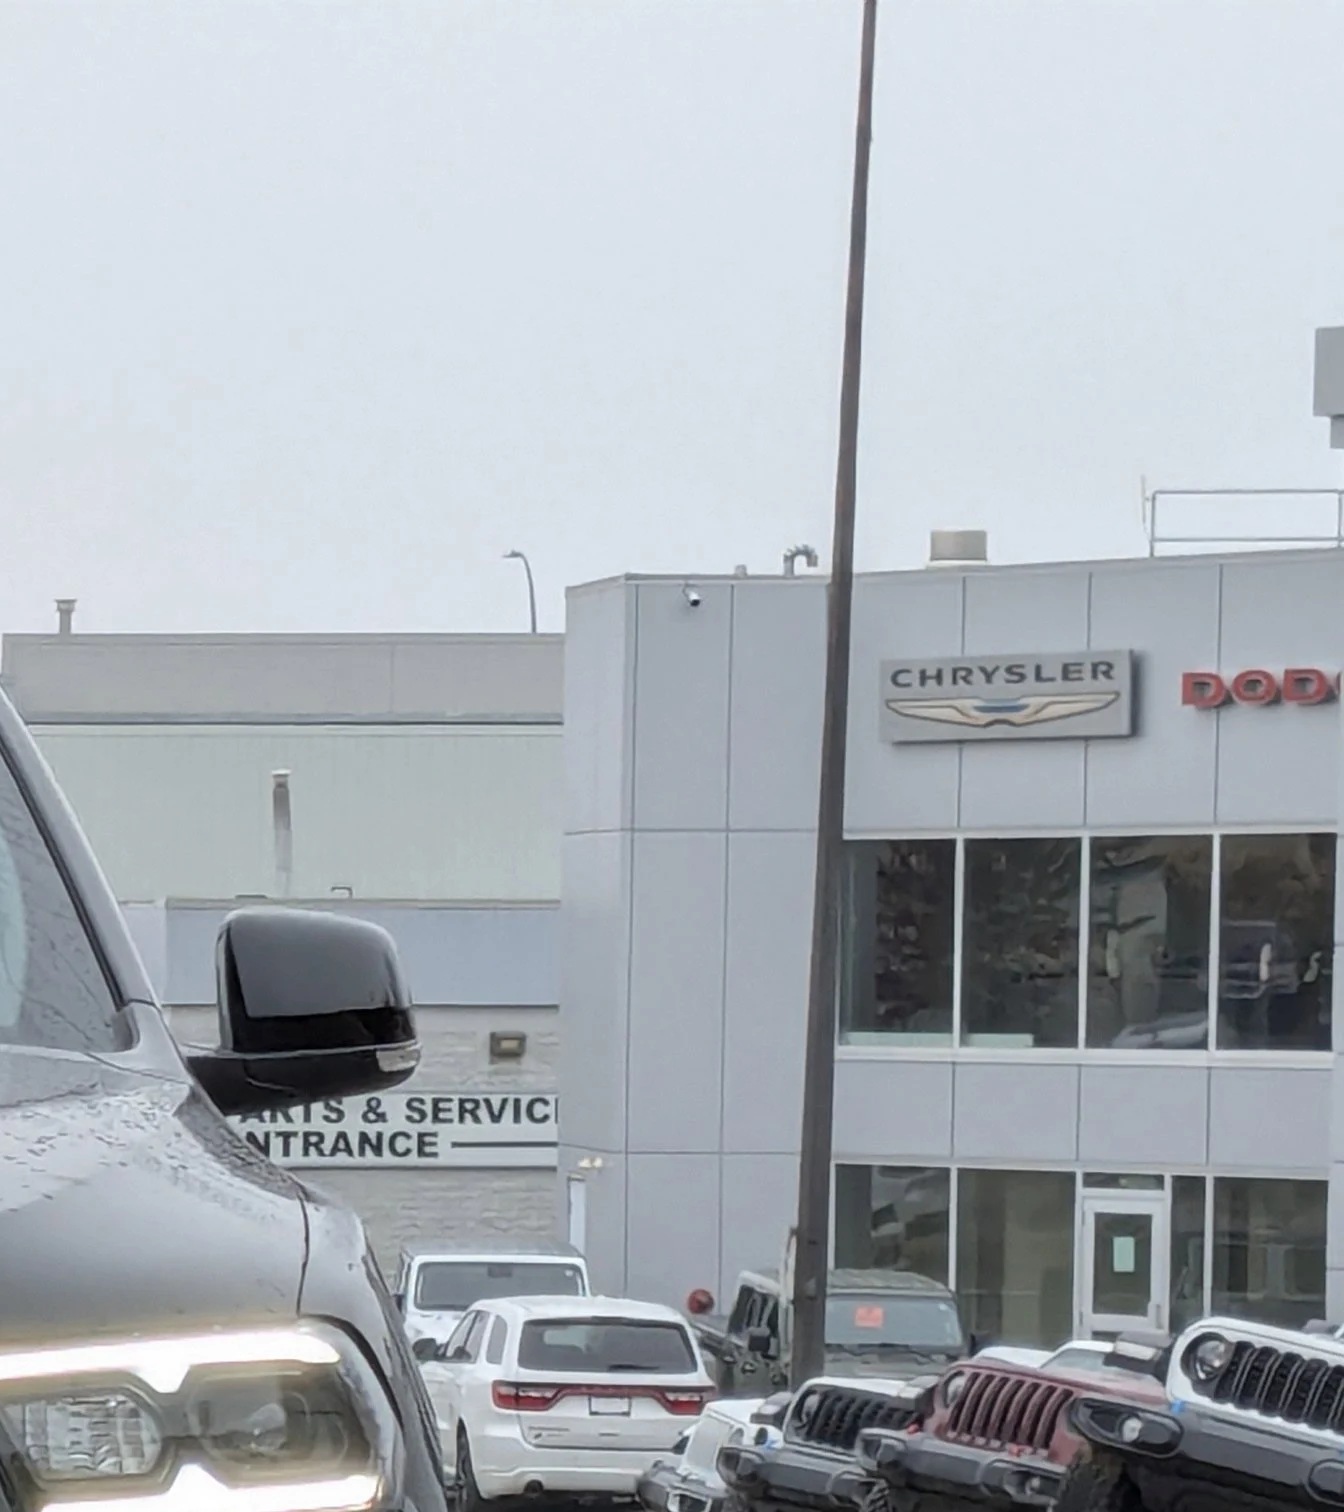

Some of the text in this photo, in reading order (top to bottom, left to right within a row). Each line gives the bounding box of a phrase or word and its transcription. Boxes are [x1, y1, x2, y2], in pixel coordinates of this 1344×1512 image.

[890, 661, 1115, 688] CHRYSLER
[1181, 668, 1340, 708] DOD
[362, 1096, 388, 1124] &
[404, 1096, 559, 1125] SERVIC
[245, 1130, 440, 1159] NTRANCE
